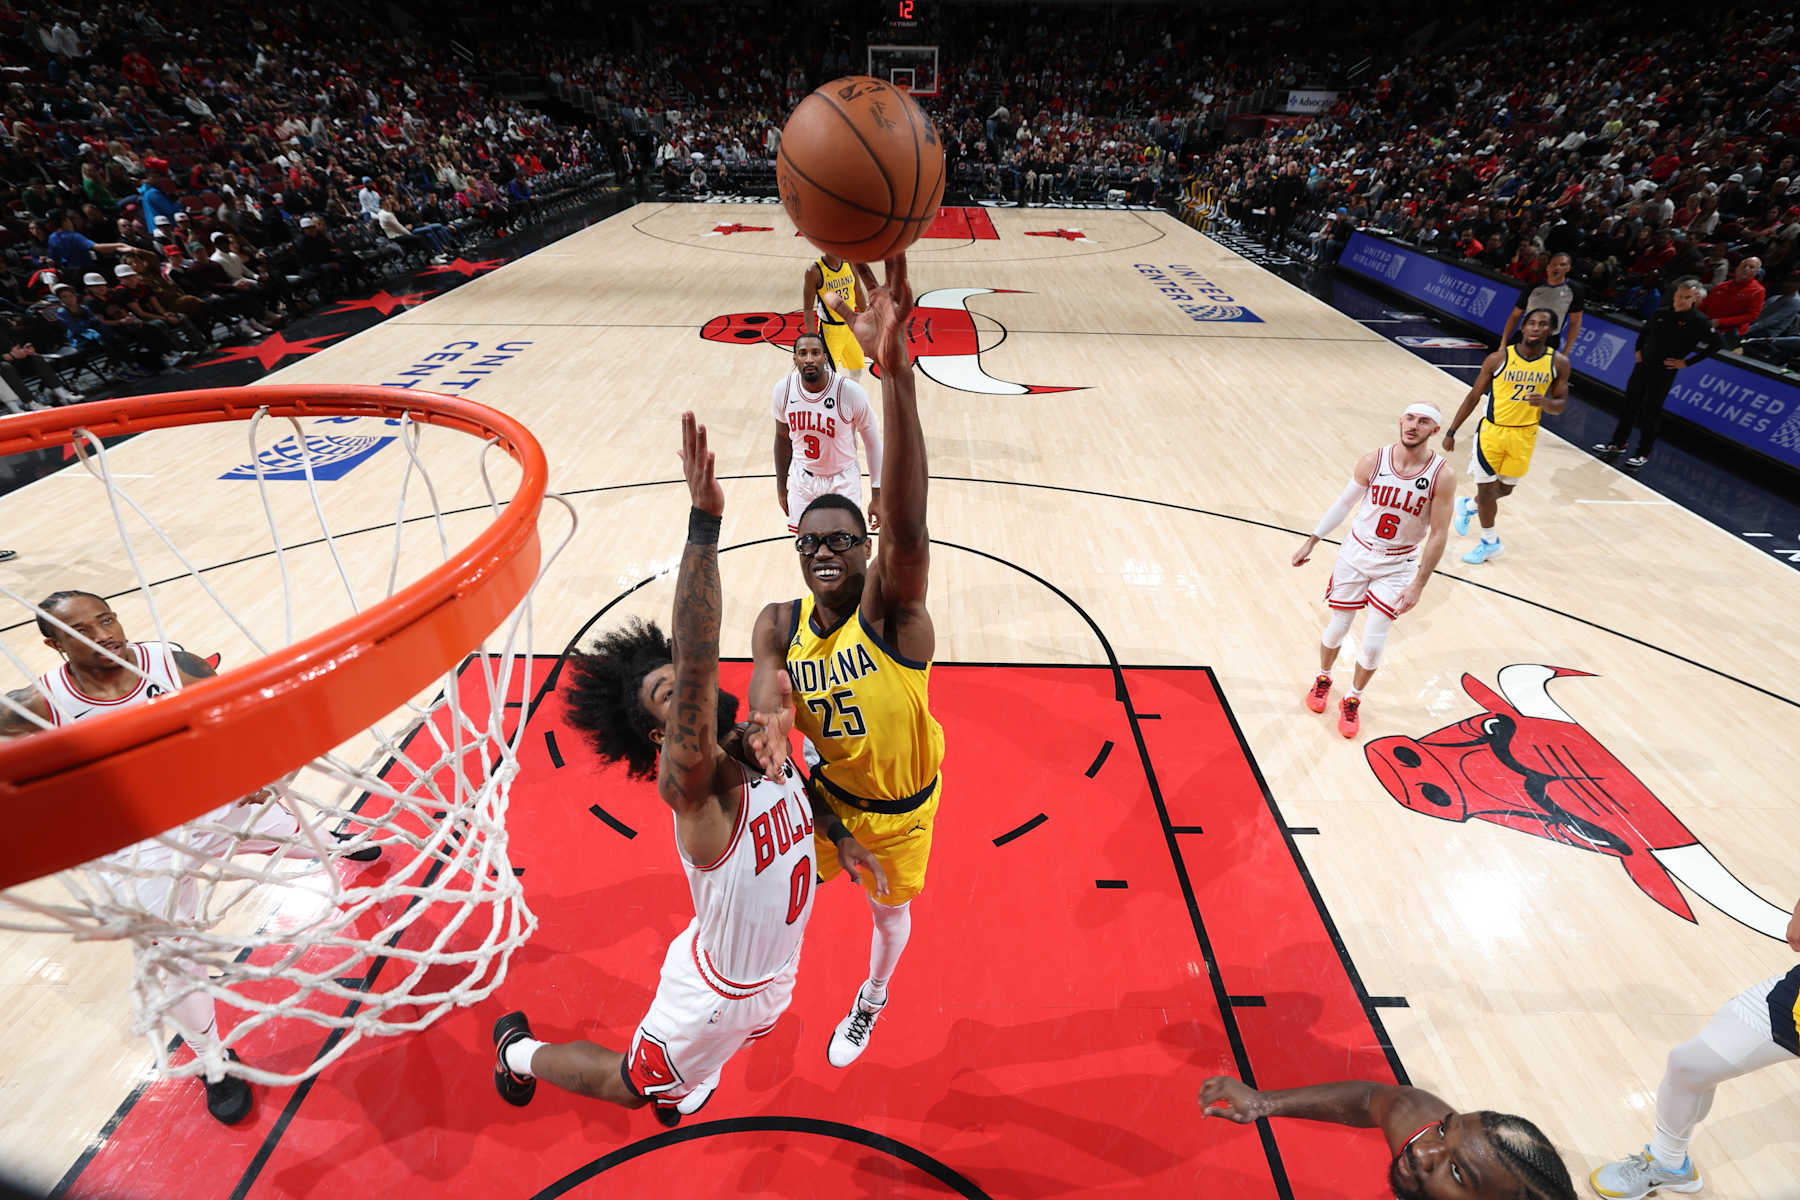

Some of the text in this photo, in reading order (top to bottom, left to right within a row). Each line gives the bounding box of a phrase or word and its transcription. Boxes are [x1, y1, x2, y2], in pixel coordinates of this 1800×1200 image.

[899, 0, 914, 19] 12
[1352, 253, 1386, 273] AIRLINES
[1364, 246, 1391, 262] UNITED
[825, 275, 853, 291] INDIANA
[1133, 264, 1194, 300] CENTER
[1168, 264, 1235, 302] UNITED
[1424, 283, 1470, 308] AIRLINES
[1440, 274, 1476, 295] UNITED
[1503, 370, 1550, 385] INDIANA
[1700, 374, 1785, 415] UNITED
[1669, 384, 1771, 433] AIRLINES
[788, 411, 835, 438] BULLS
[804, 434, 820, 460] 3
[1371, 485, 1427, 517] BULLS
[1375, 513, 1400, 540] 6
[787, 642, 878, 692] NDIANA
[806, 690, 867, 738] 25
[750, 788, 814, 876] BULL
[786, 855, 811, 926] 0
